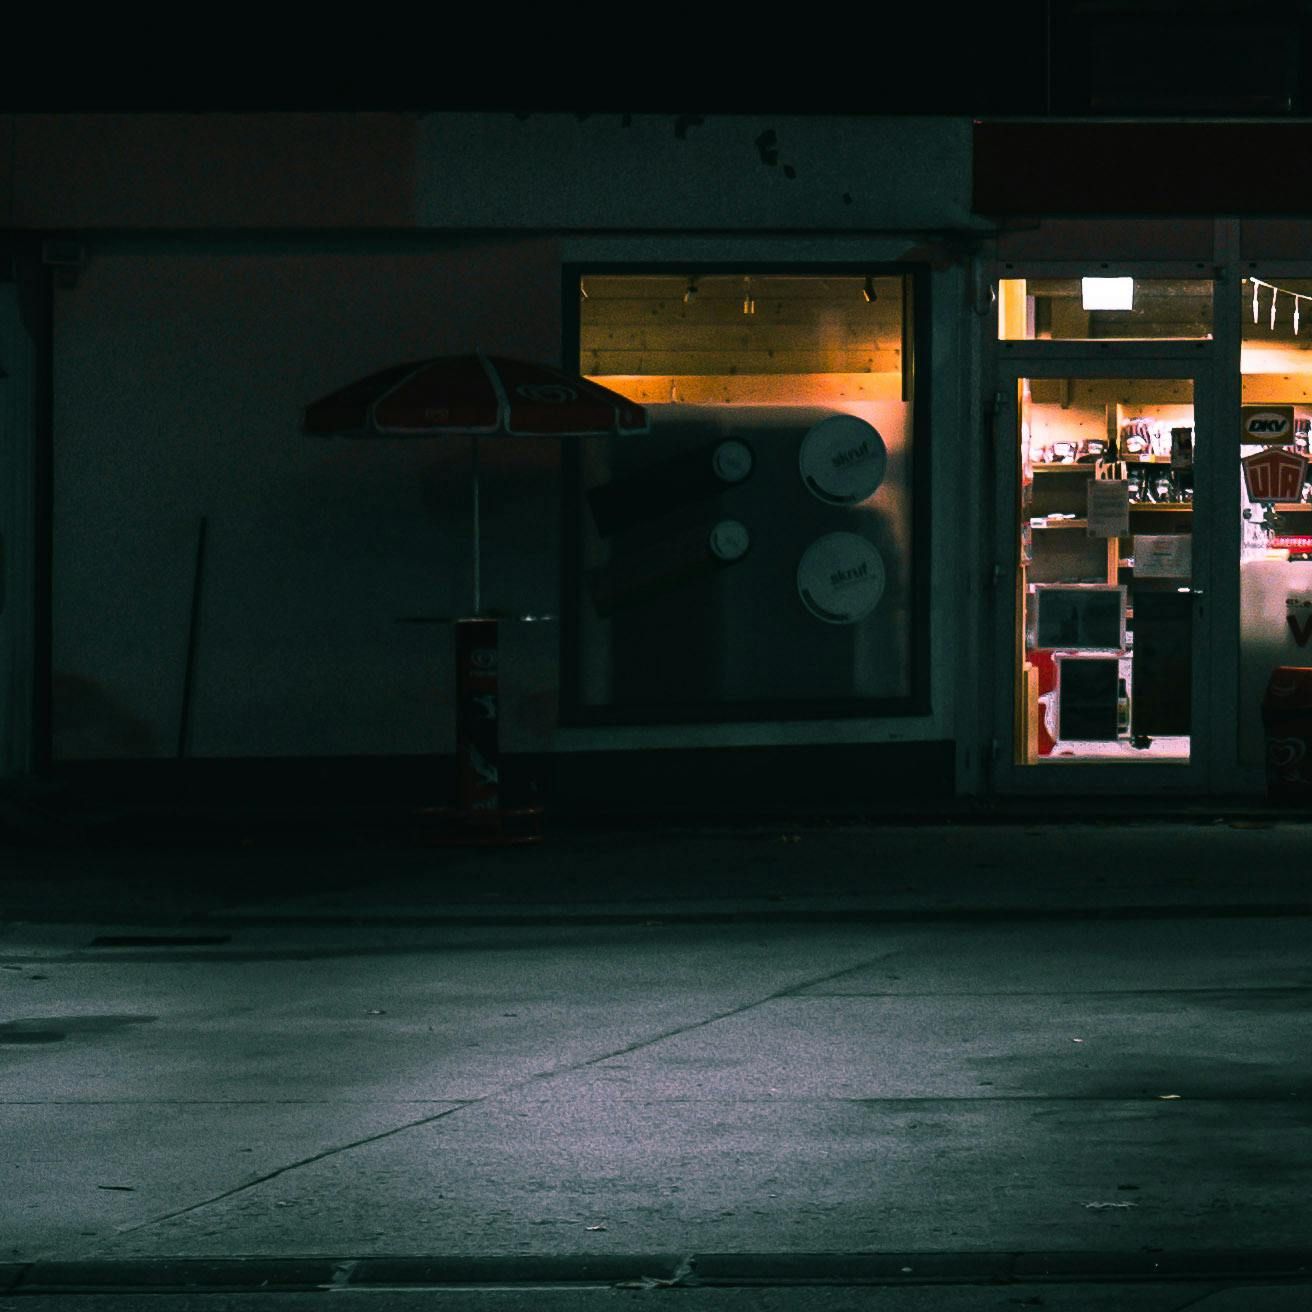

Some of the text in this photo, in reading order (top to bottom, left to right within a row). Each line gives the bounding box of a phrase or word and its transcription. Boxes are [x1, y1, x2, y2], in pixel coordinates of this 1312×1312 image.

[1249, 419, 1287, 434] DKV
[831, 441, 869, 468] skruf
[1247, 450, 1304, 499] UTA
[830, 562, 868, 586] skruf
